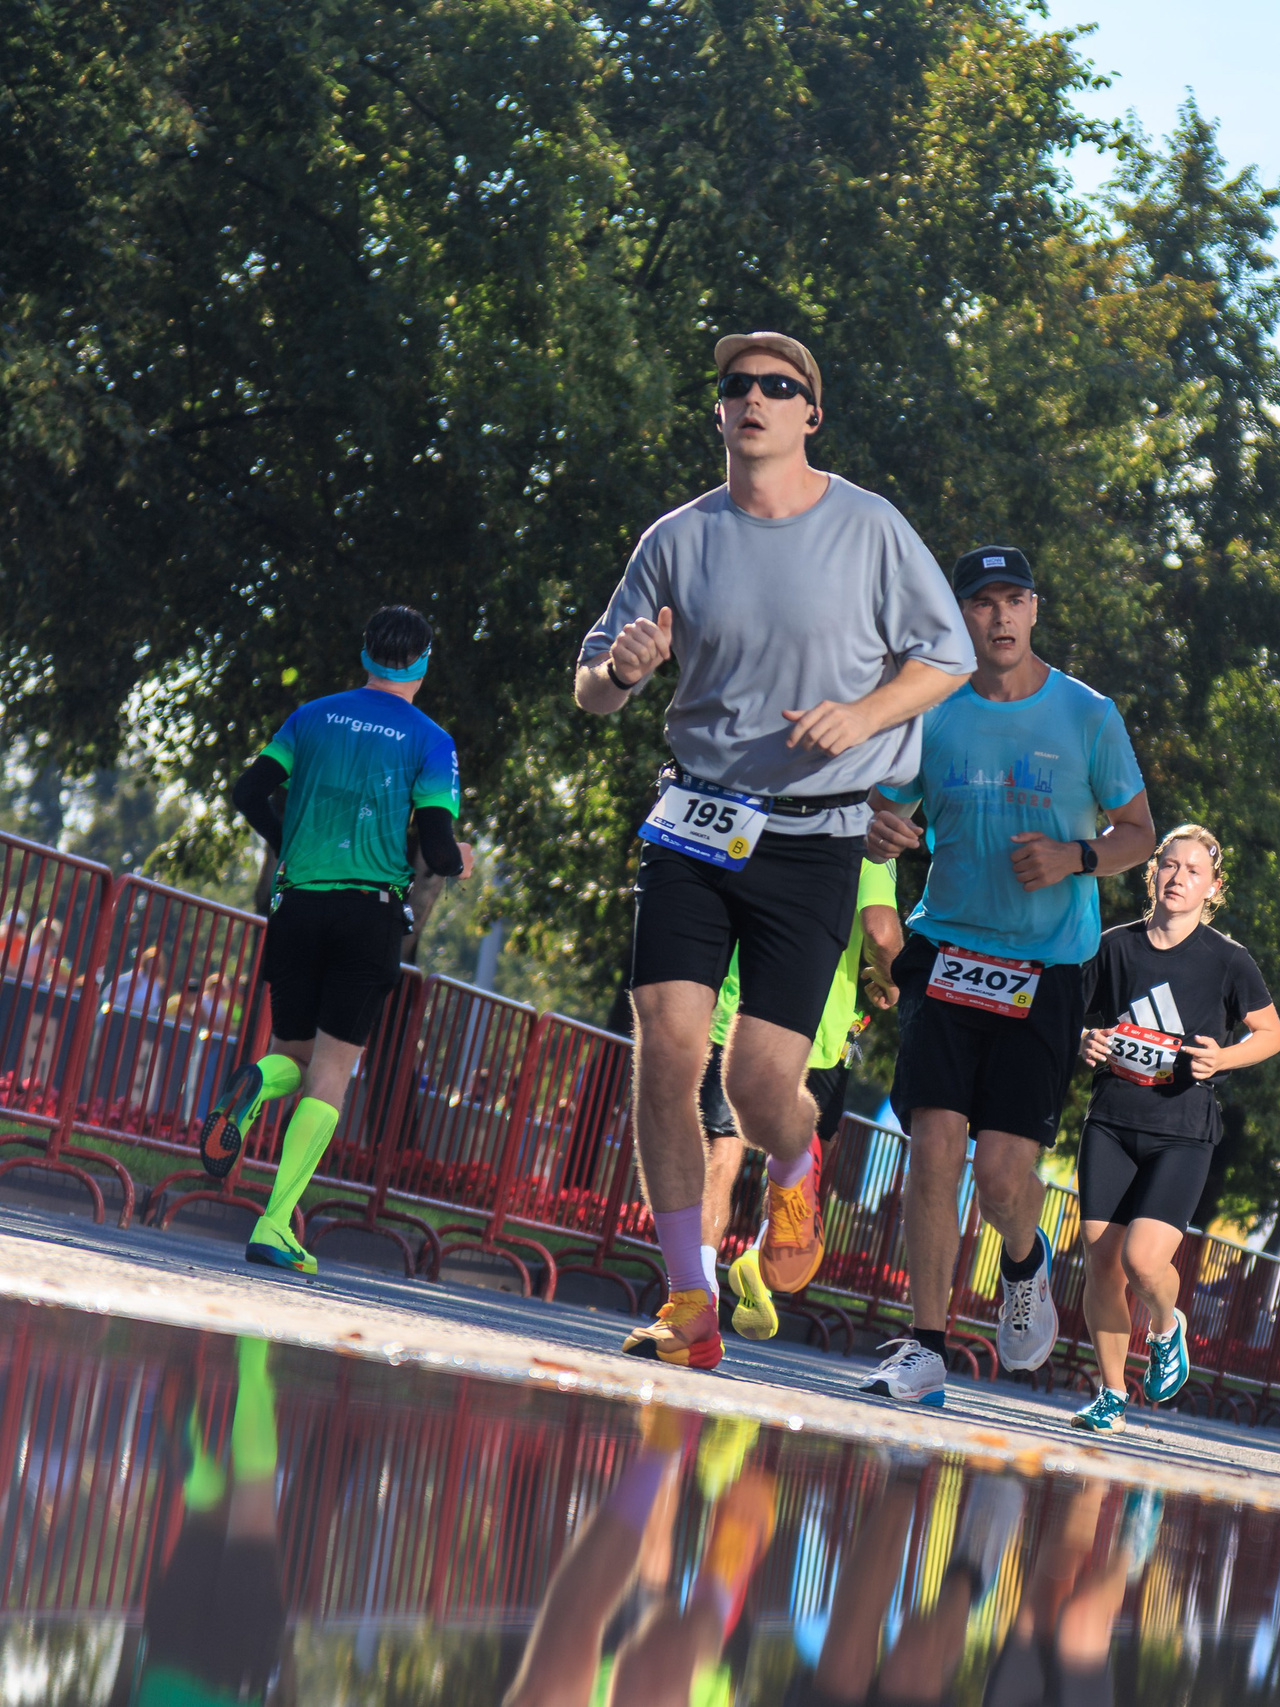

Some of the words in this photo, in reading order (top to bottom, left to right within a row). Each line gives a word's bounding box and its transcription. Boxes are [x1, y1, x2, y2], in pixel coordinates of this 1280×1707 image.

[326, 712, 406, 742] Yurganov
[682, 799, 738, 834] 195
[942, 961, 1030, 994] 2407
[1112, 1037, 1164, 1069] 3231
